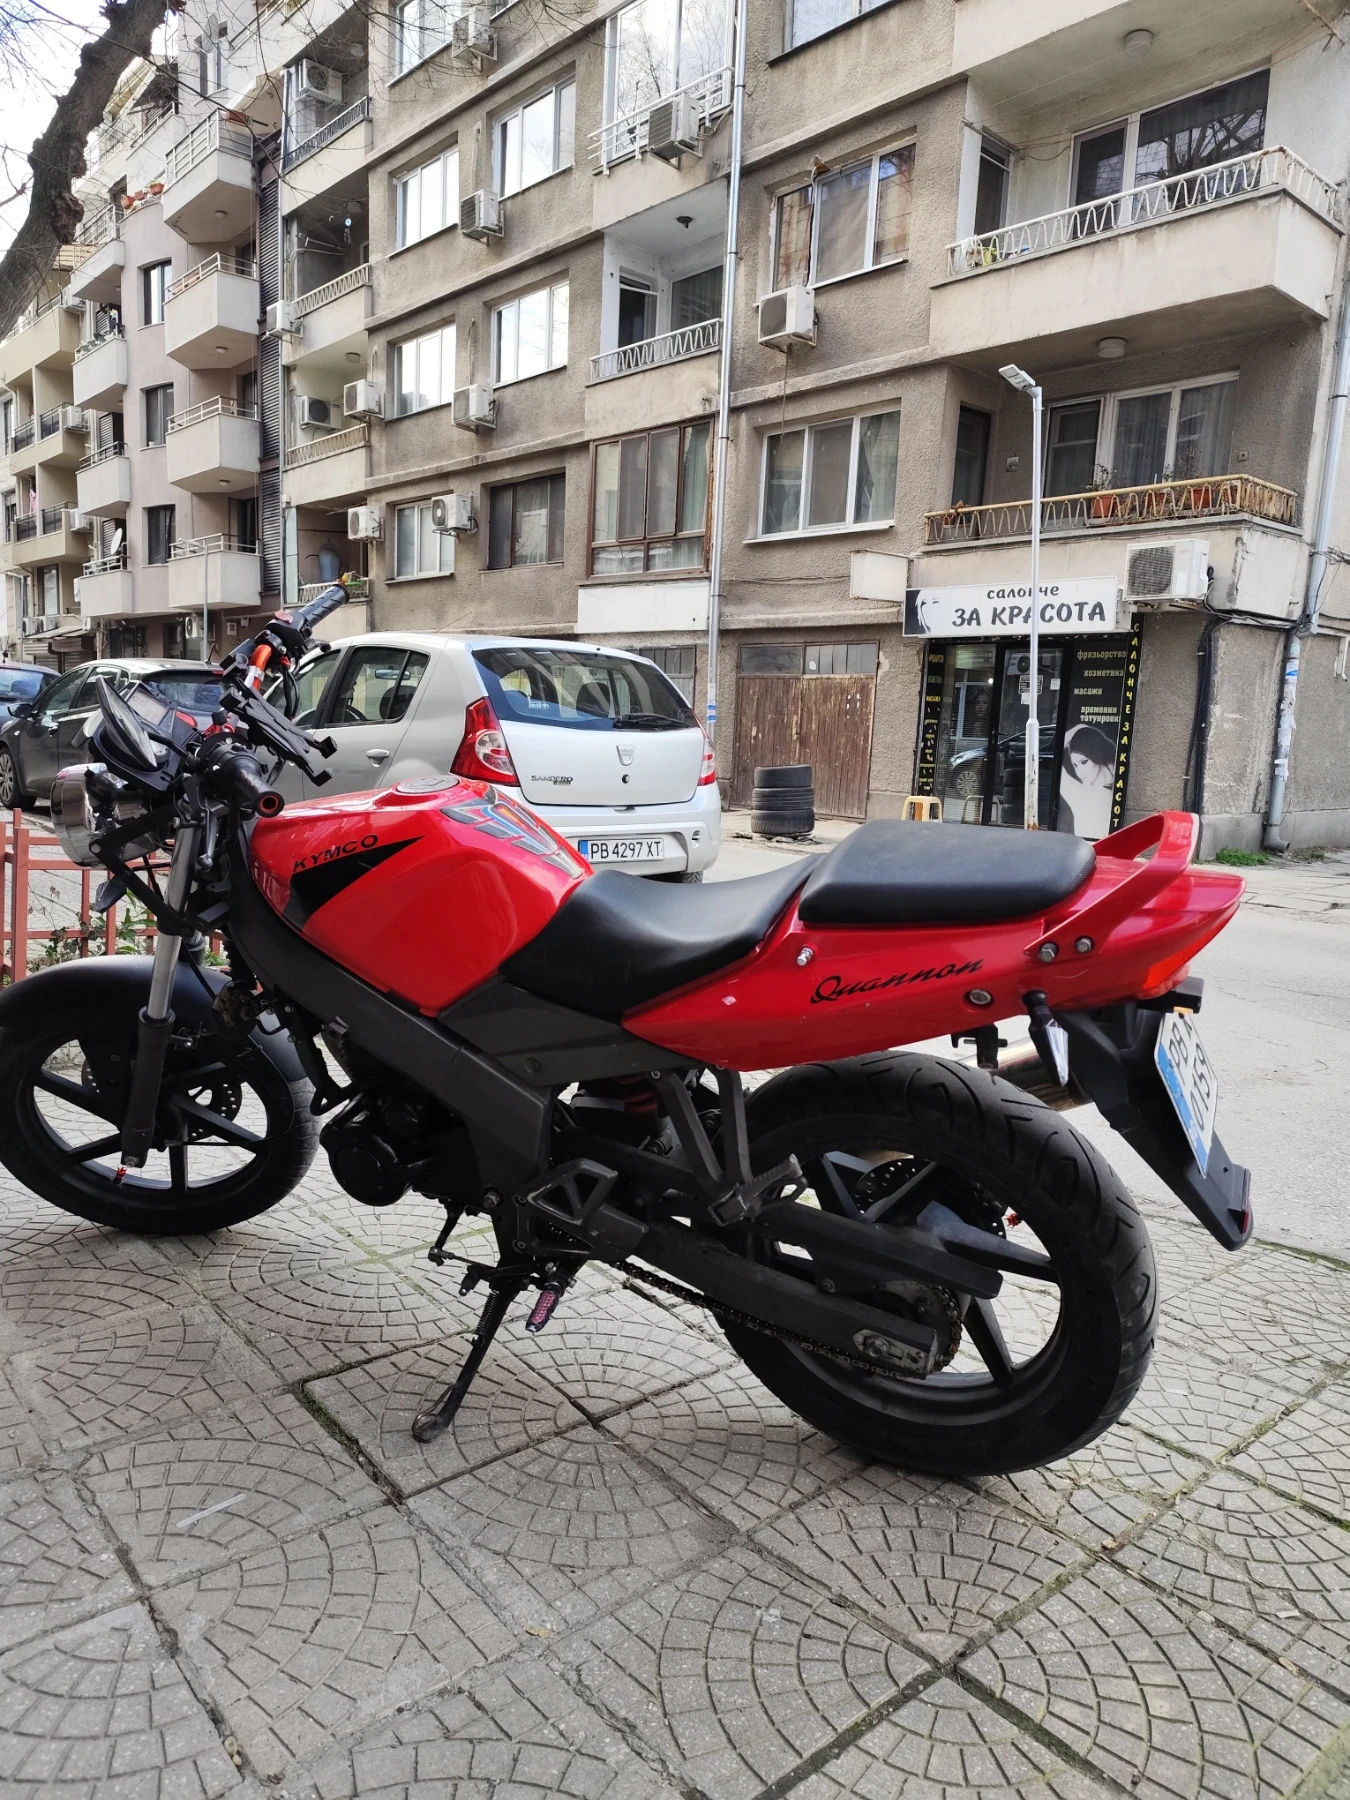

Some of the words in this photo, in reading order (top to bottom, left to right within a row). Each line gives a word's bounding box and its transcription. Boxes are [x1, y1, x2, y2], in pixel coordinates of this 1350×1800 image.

[952, 607, 982, 628] ЗА
[1077, 650, 1127, 660] фризьорство
[1084, 669, 1124, 677] козметика
[1125, 623, 1140, 714] САЛОНЧЕ
[1073, 687, 1102, 695] масажи
[1081, 706, 1118, 715] временни
[1122, 721, 1130, 745] ЗА
[531, 775, 574, 783] SANDERO
[1112, 752, 1127, 828] КРАСОТ
[293, 834, 379, 873] KYMCO
[590, 842, 609, 859] PB
[612, 842, 643, 858] 4297
[646, 841, 661, 857] XT
[810, 958, 984, 1004] Quannon
[1168, 1020, 1189, 1087] PB
[1189, 1041, 1212, 1132] 0159
